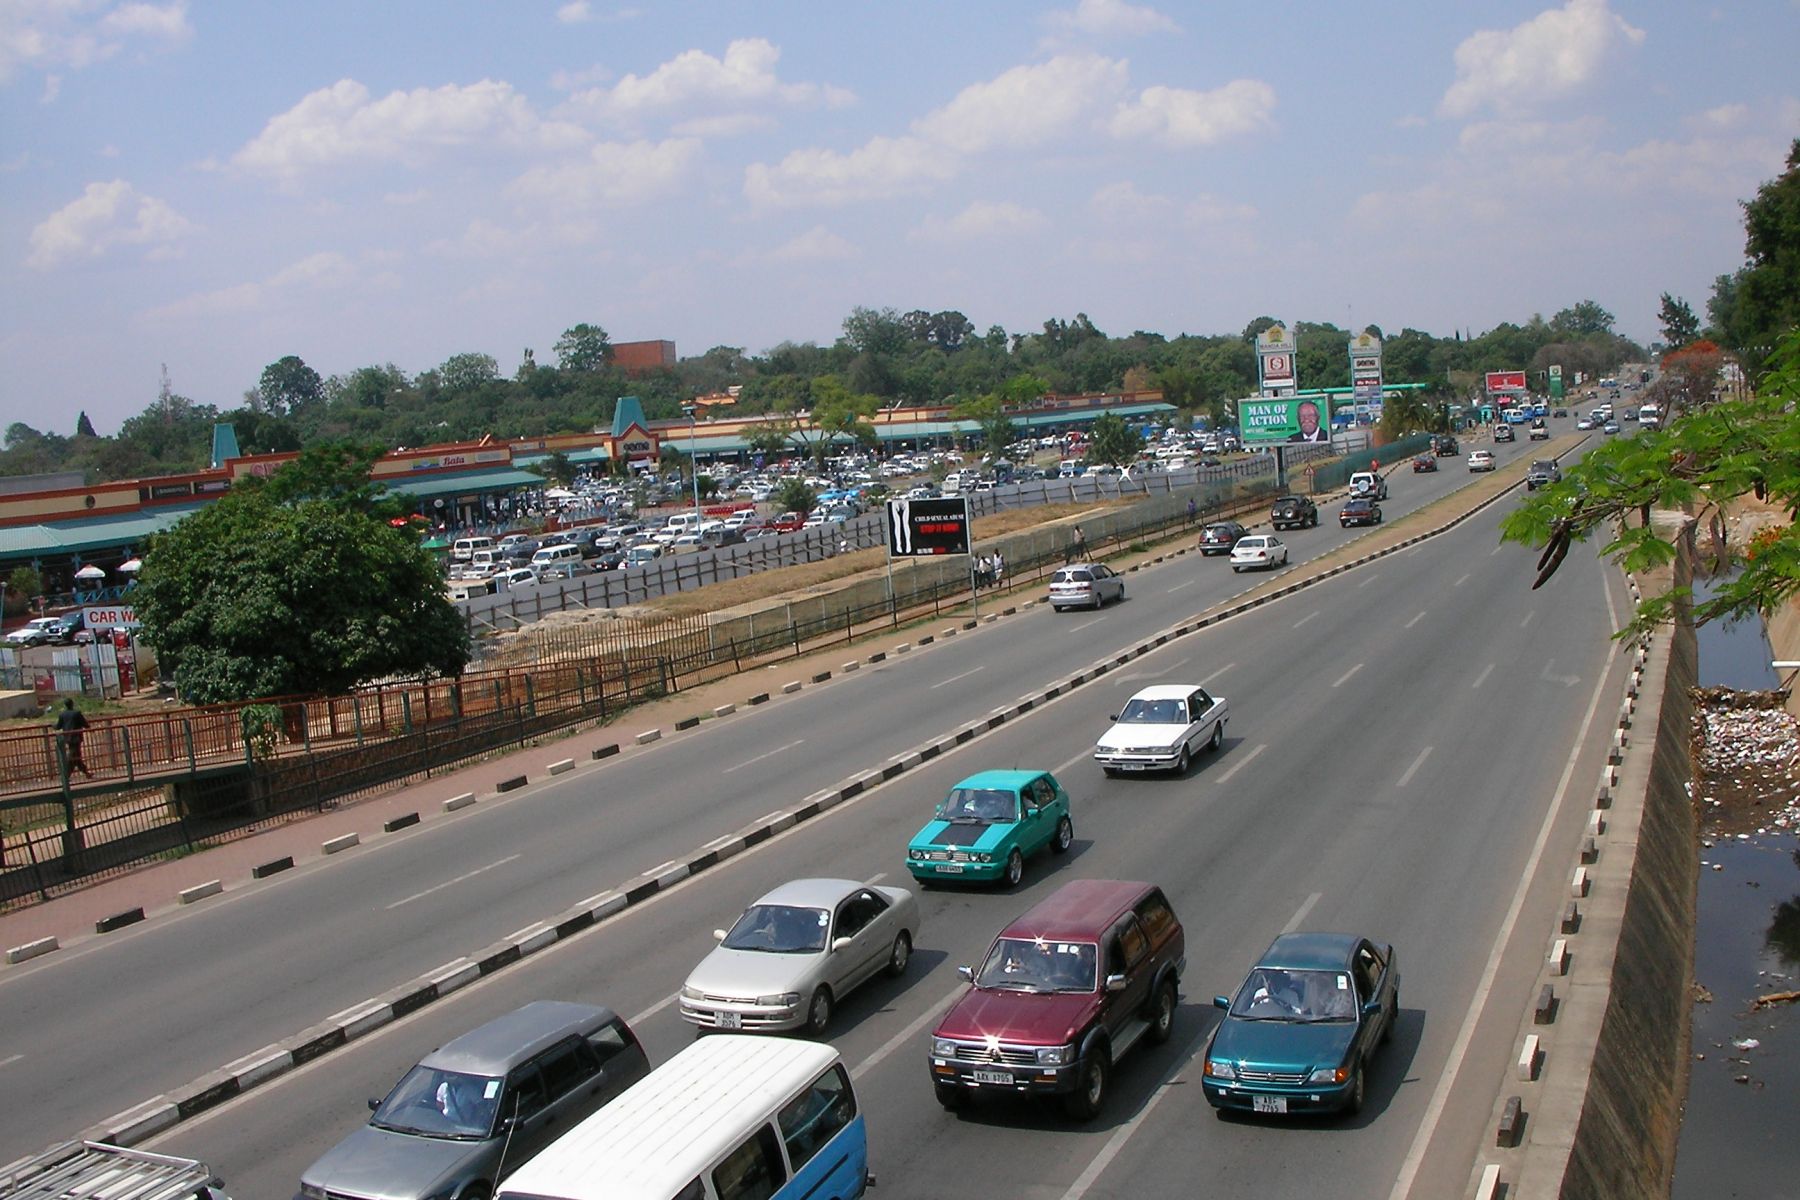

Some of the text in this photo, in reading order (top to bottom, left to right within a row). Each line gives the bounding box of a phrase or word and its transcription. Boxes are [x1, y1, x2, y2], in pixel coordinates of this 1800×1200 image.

[1248, 404, 1288, 416] MAN OF
[1249, 415, 1288, 426] ACTION
[89, 611, 117, 623] CAR
